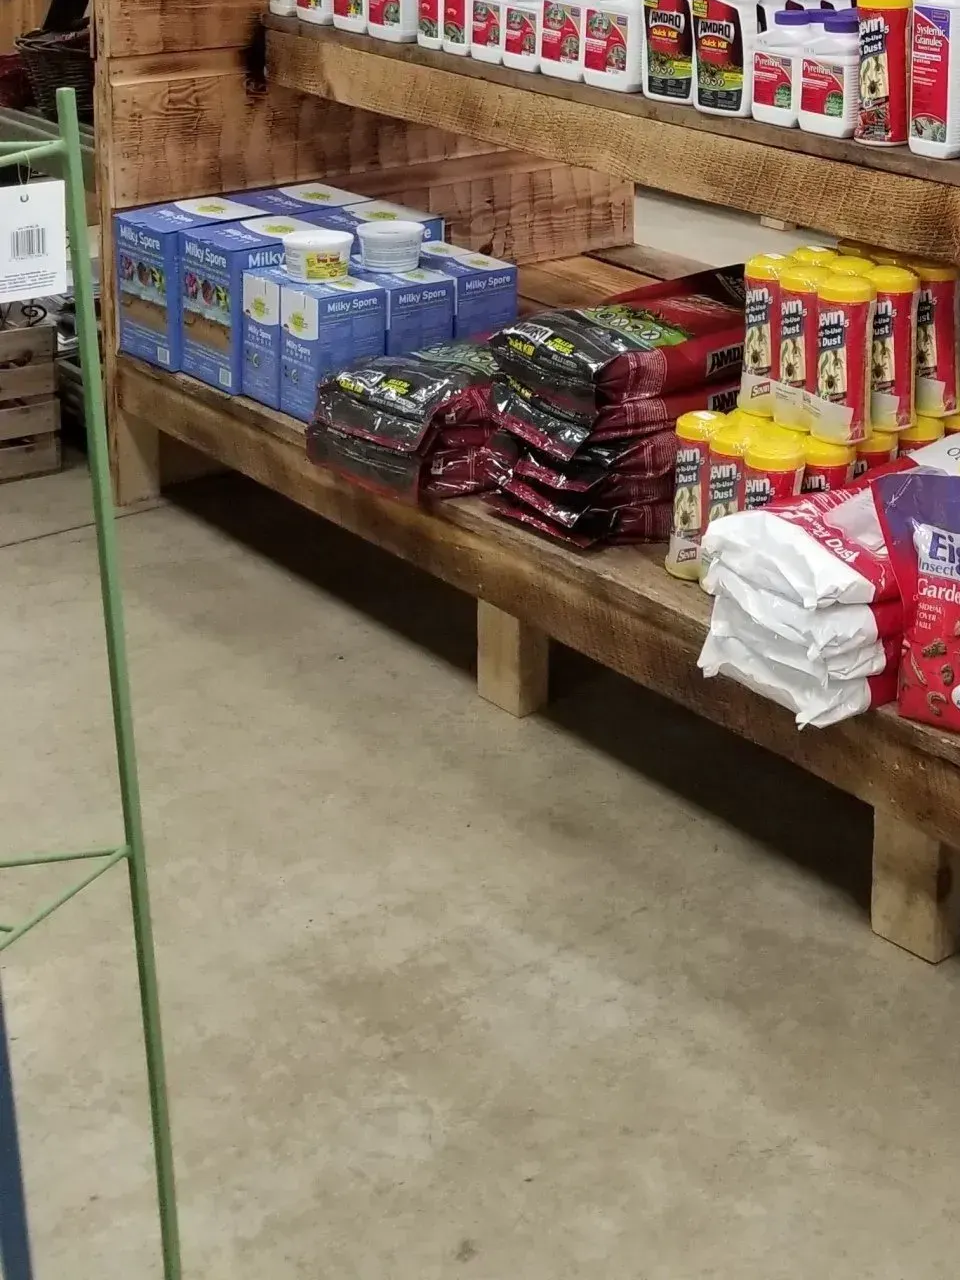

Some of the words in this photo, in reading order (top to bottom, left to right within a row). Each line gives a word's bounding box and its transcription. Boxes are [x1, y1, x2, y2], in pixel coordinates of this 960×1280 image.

[651, 11, 681, 29] AMDRO
[700, 21, 731, 38] AMDRO
[916, 23, 945, 37] Systemic
[864, 42, 882, 53] Dust
[915, 34, 942, 47] Granules
[120, 224, 138, 247] Milky
[139, 233, 160, 251] Spore
[186, 242, 204, 264] Milky
[205, 248, 227, 268] Spore
[249, 252, 285, 268] Milky
[465, 278, 488, 292] Milky
[488, 274, 511, 287] Spore
[399, 291, 421, 306] Milky
[422, 288, 447, 302] Spore
[328, 300, 351, 314] Milky
[352, 296, 378, 310] Spore
[749, 312, 766, 323] Dust
[783, 324, 800, 335] Dust
[823, 336, 841, 347] Dust
[678, 473, 697, 483] Dust
[714, 488, 733, 499] Dust
